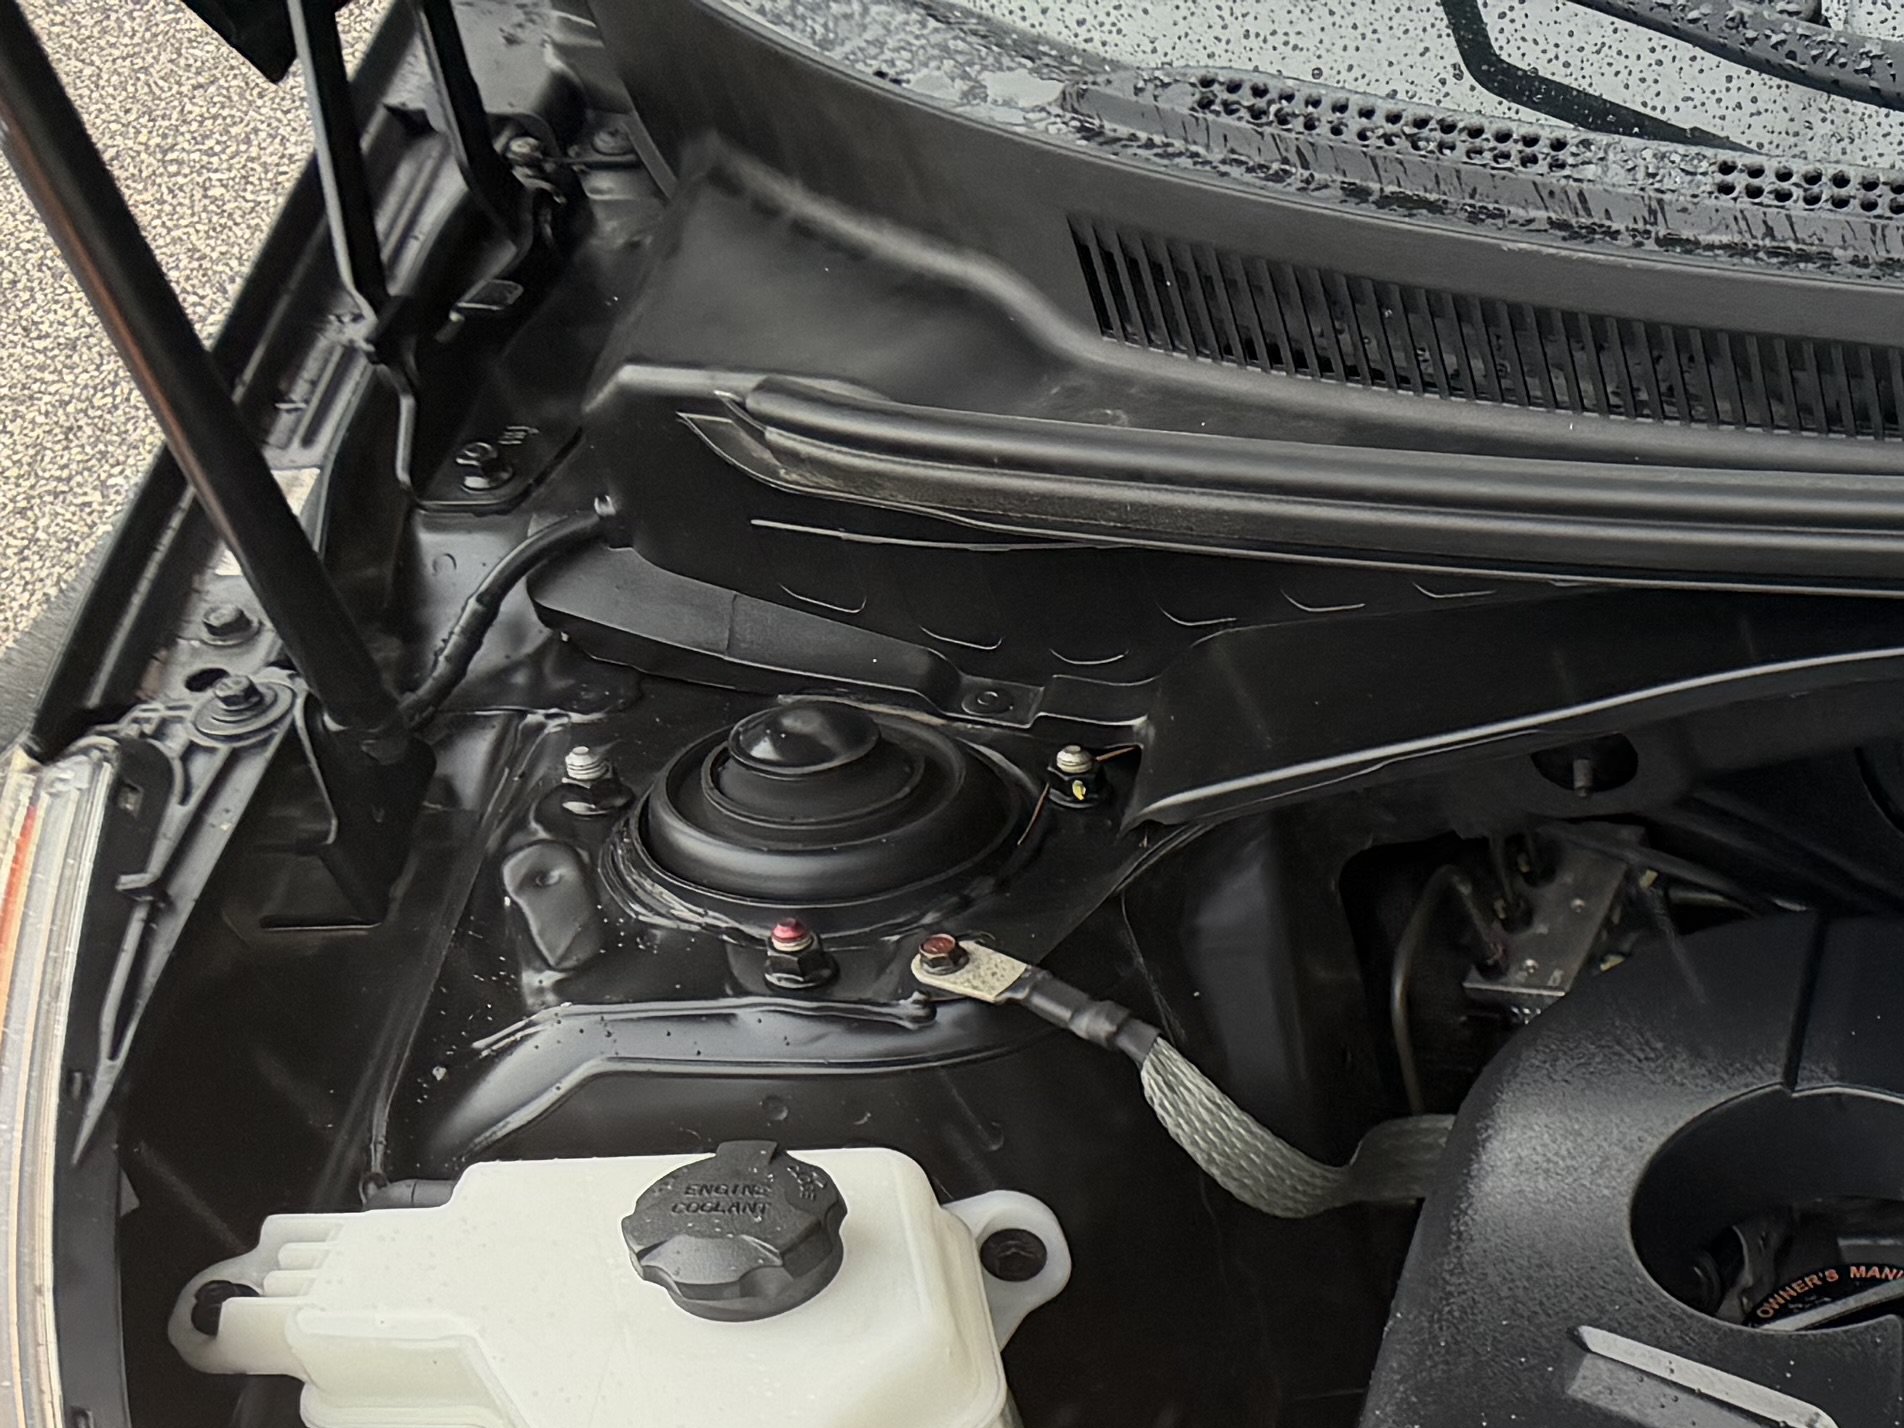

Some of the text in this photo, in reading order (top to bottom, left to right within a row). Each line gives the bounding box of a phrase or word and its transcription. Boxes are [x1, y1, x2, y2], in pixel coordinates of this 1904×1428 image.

[671, 1201, 773, 1215] COOLANT
[1756, 1268, 1840, 1318] OWNER'S
[1849, 1265, 1904, 1281] MAN
